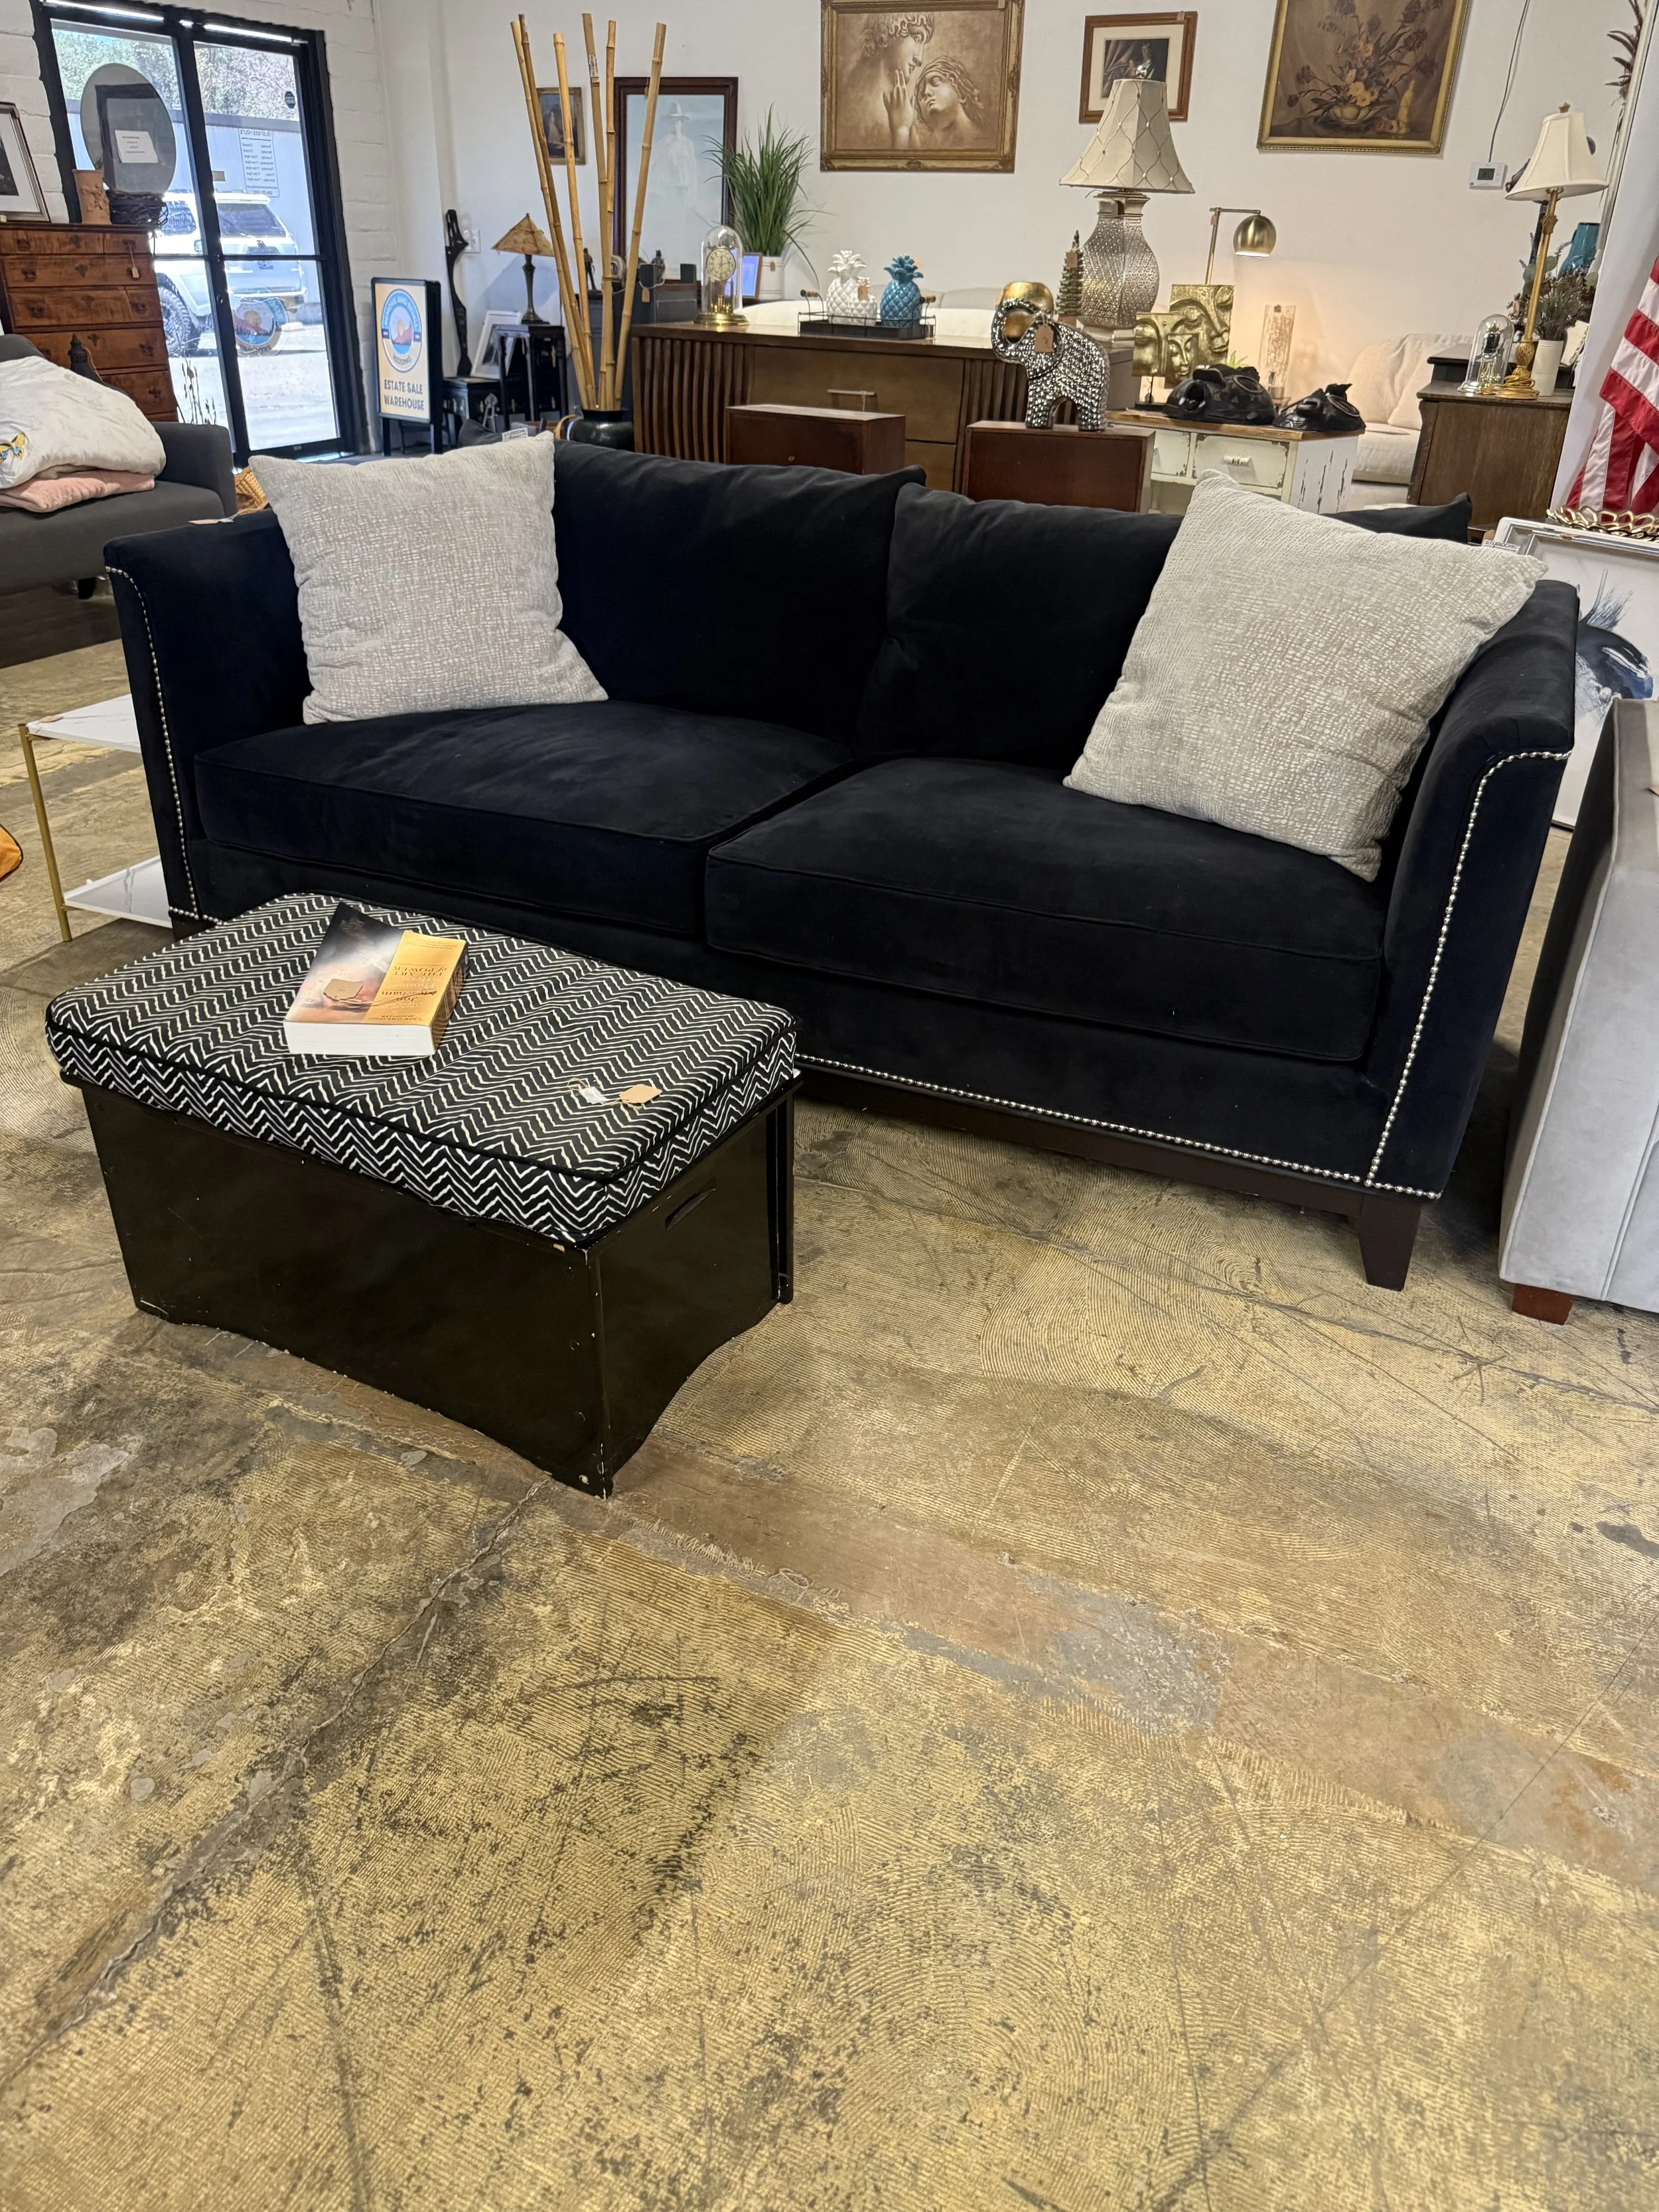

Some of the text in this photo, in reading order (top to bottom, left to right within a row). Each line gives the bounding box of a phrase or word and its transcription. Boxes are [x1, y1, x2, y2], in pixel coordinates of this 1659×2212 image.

[384, 379, 423, 394] ESTATE SALE
[384, 394, 425, 410] WAREHOUSE
